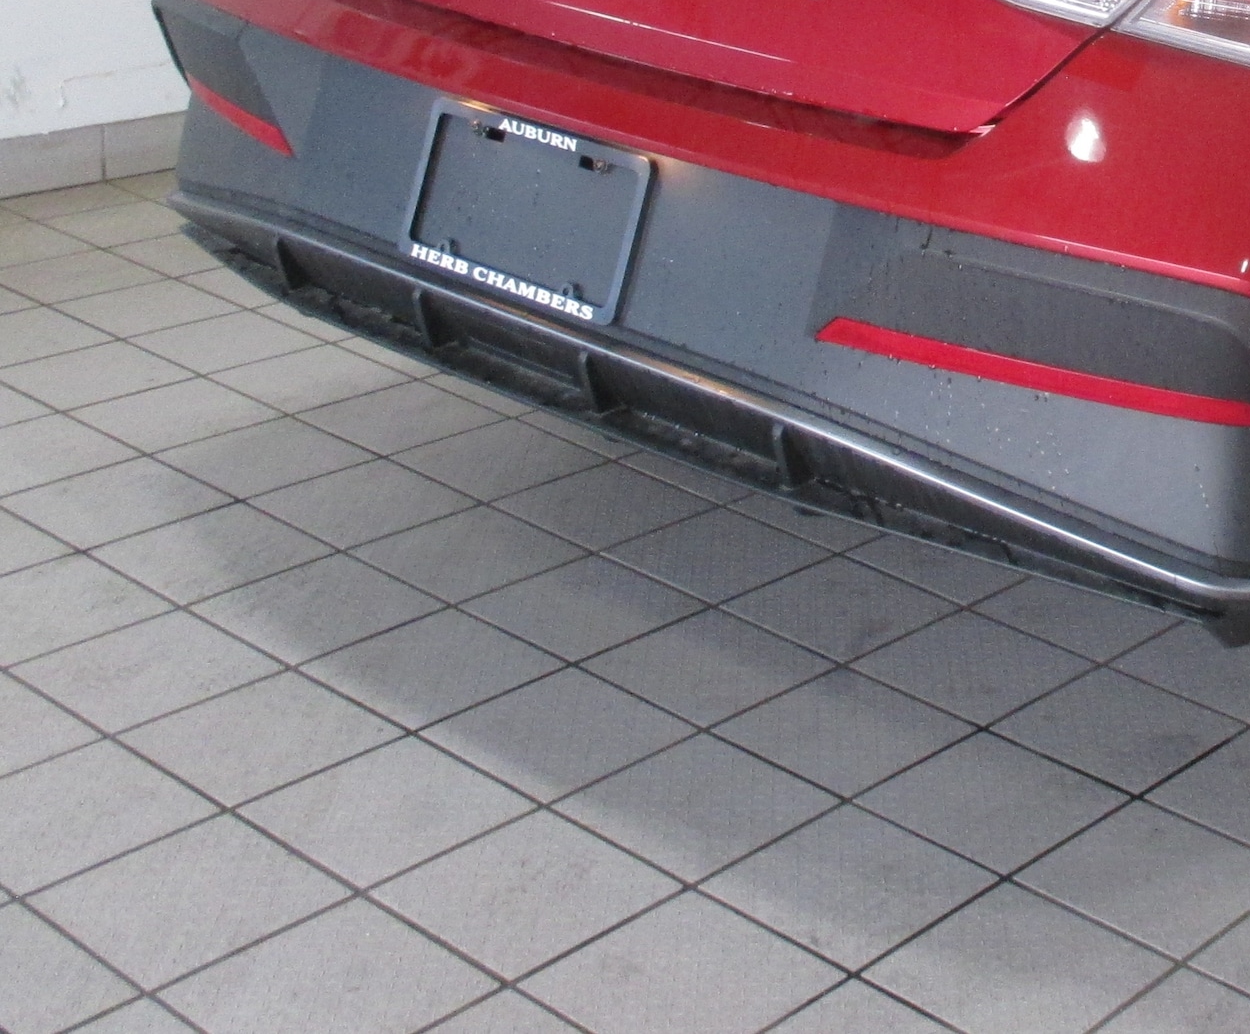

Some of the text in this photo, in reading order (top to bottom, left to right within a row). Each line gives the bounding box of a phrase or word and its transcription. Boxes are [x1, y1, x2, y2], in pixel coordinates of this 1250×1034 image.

[498, 118, 578, 152] AUBURN
[411, 243, 594, 321] HERB CHAMBERS
